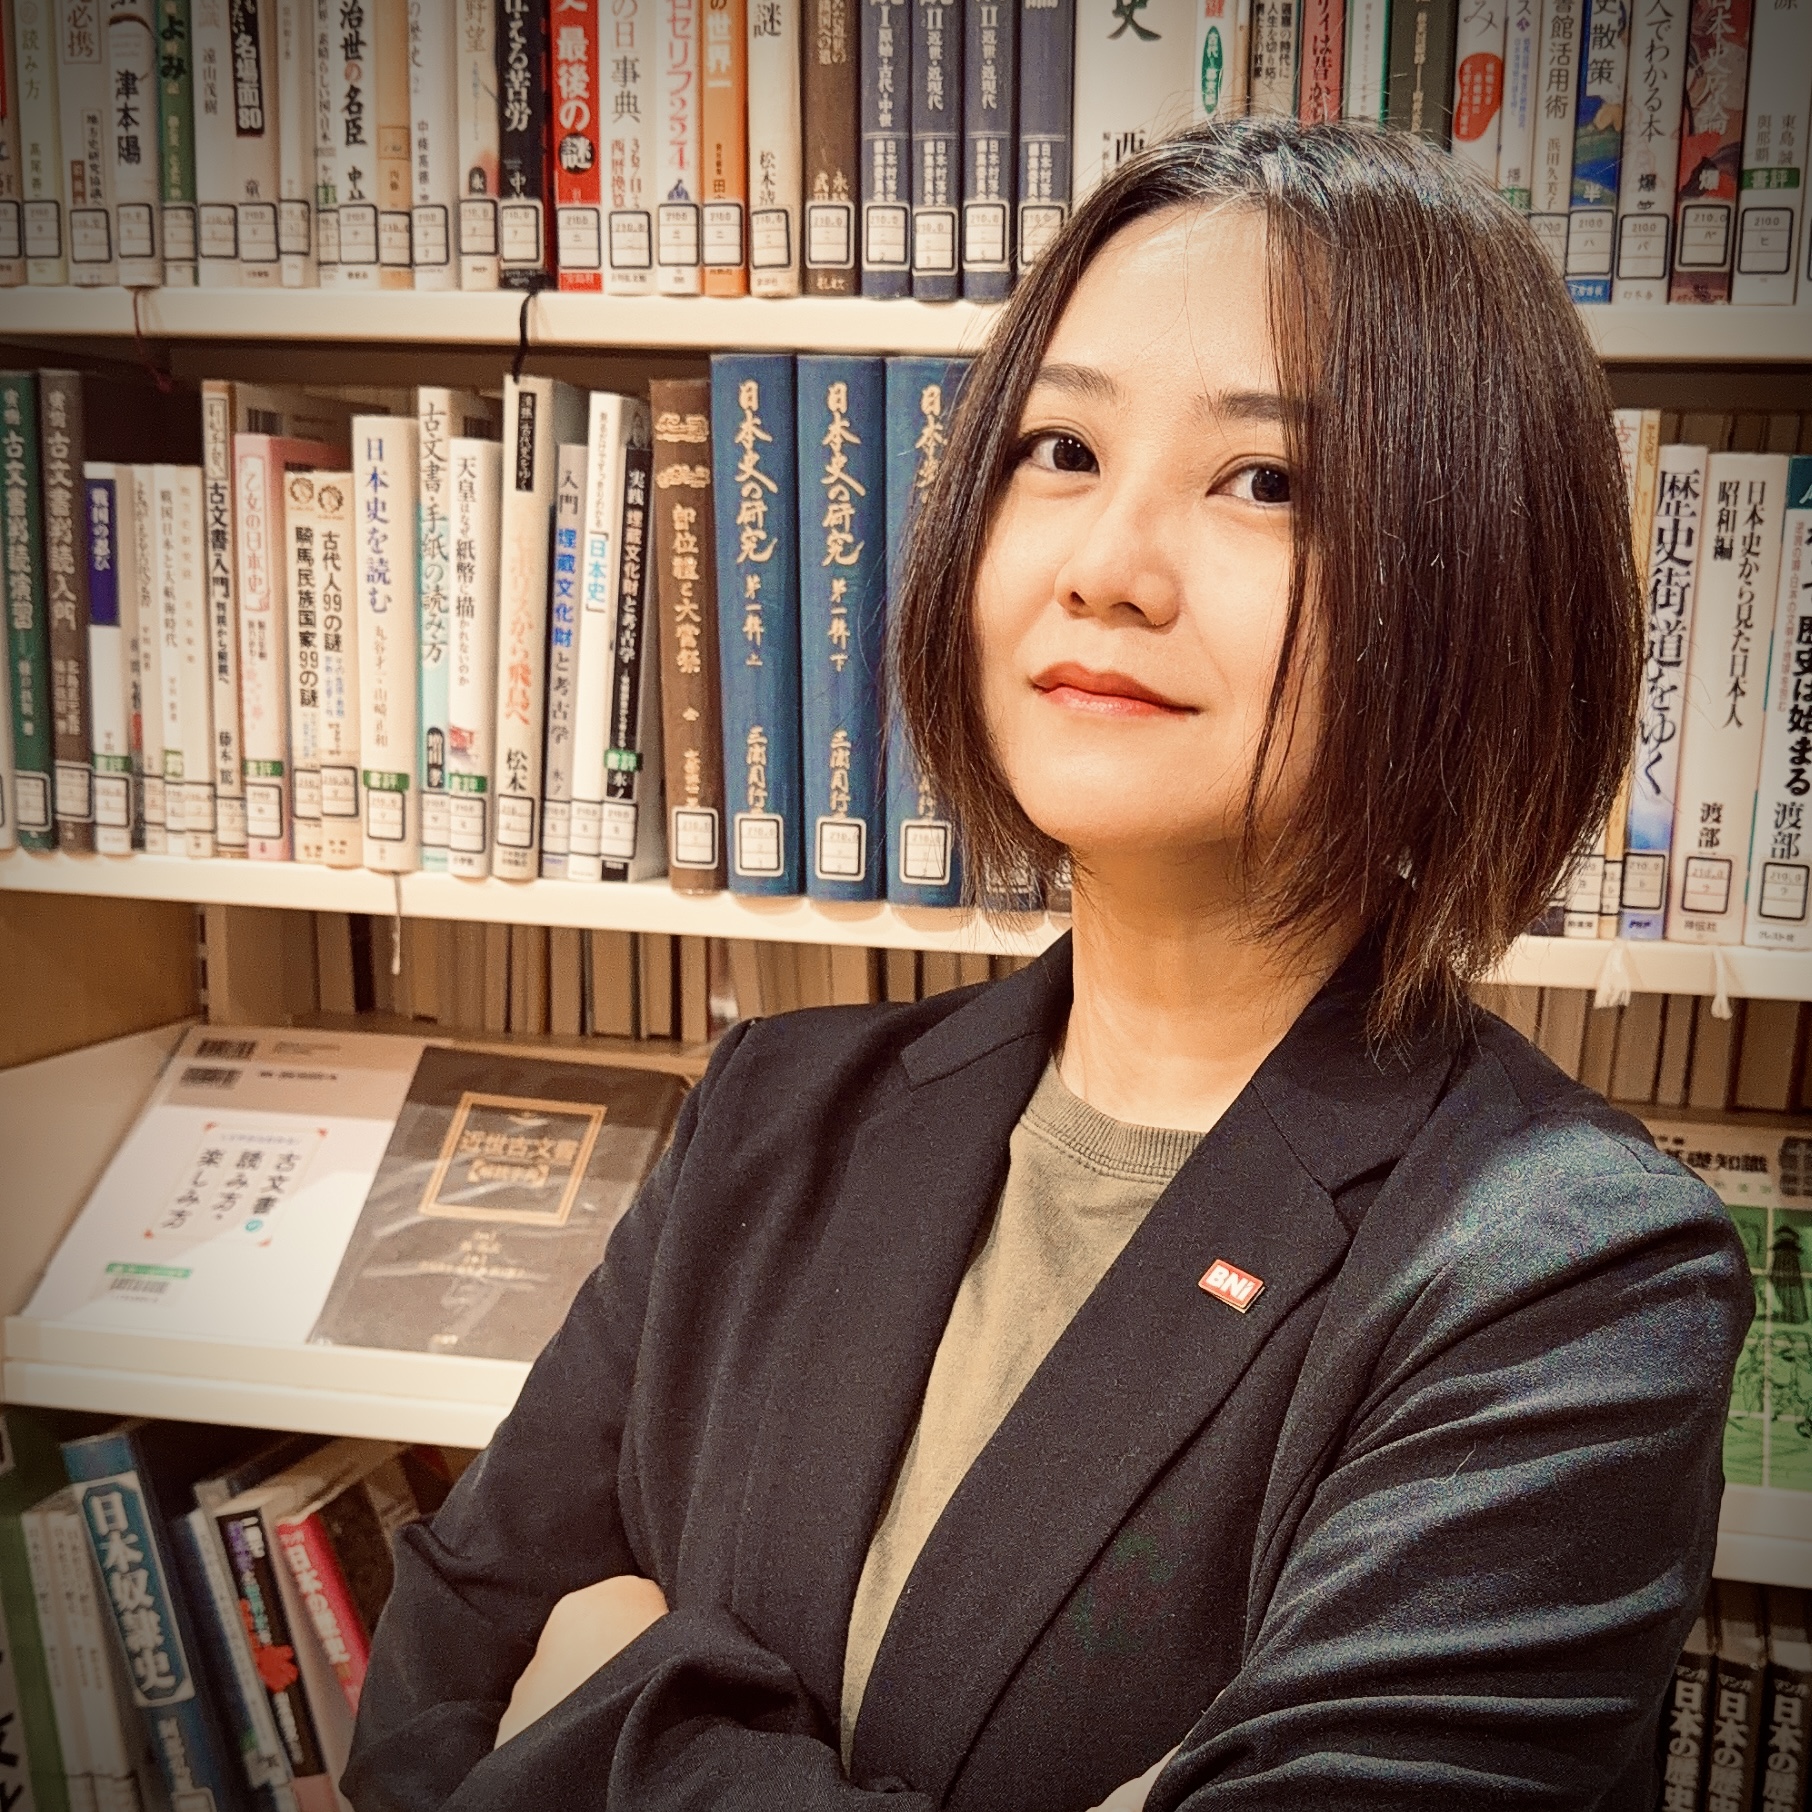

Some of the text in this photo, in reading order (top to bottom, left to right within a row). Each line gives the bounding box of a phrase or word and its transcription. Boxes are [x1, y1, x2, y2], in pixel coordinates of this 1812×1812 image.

[339, 4, 366, 146] 治世の名臣
[610, 0, 642, 124] の日事典
[753, 2, 782, 39] 謎
[115, 69, 143, 166] 津本陽
[235, 34, 264, 130] 名場面80
[556, 25, 595, 173] 最後の謎
[1778, 114, 1797, 166] 東島誠
[365, 436, 393, 614] 日本史を読む
[559, 470, 579, 515] 入門
[735, 379, 779, 565] 日本史の研究
[820, 381, 867, 568] 日本史の研究
[1712, 480, 1741, 561] 昭和編
[206, 481, 230, 600] 古文書入門
[321, 530, 343, 652] 古代人99の謎
[421, 402, 450, 665] 古文書・手紙の読み方
[295, 526, 319, 708] 騎馬民族国家99の謎
[1637, 468, 1701, 796] 歴史街道をゆく
[1722, 480, 1767, 729] 日本史から見た日本人
[506, 747, 529, 792] 松本
[1697, 801, 1723, 848] 渡部
[1769, 801, 1805, 859] 渡部
[1205, 1264, 1256, 1301] BNI
[90, 1491, 177, 1691] 日本奴隷史
